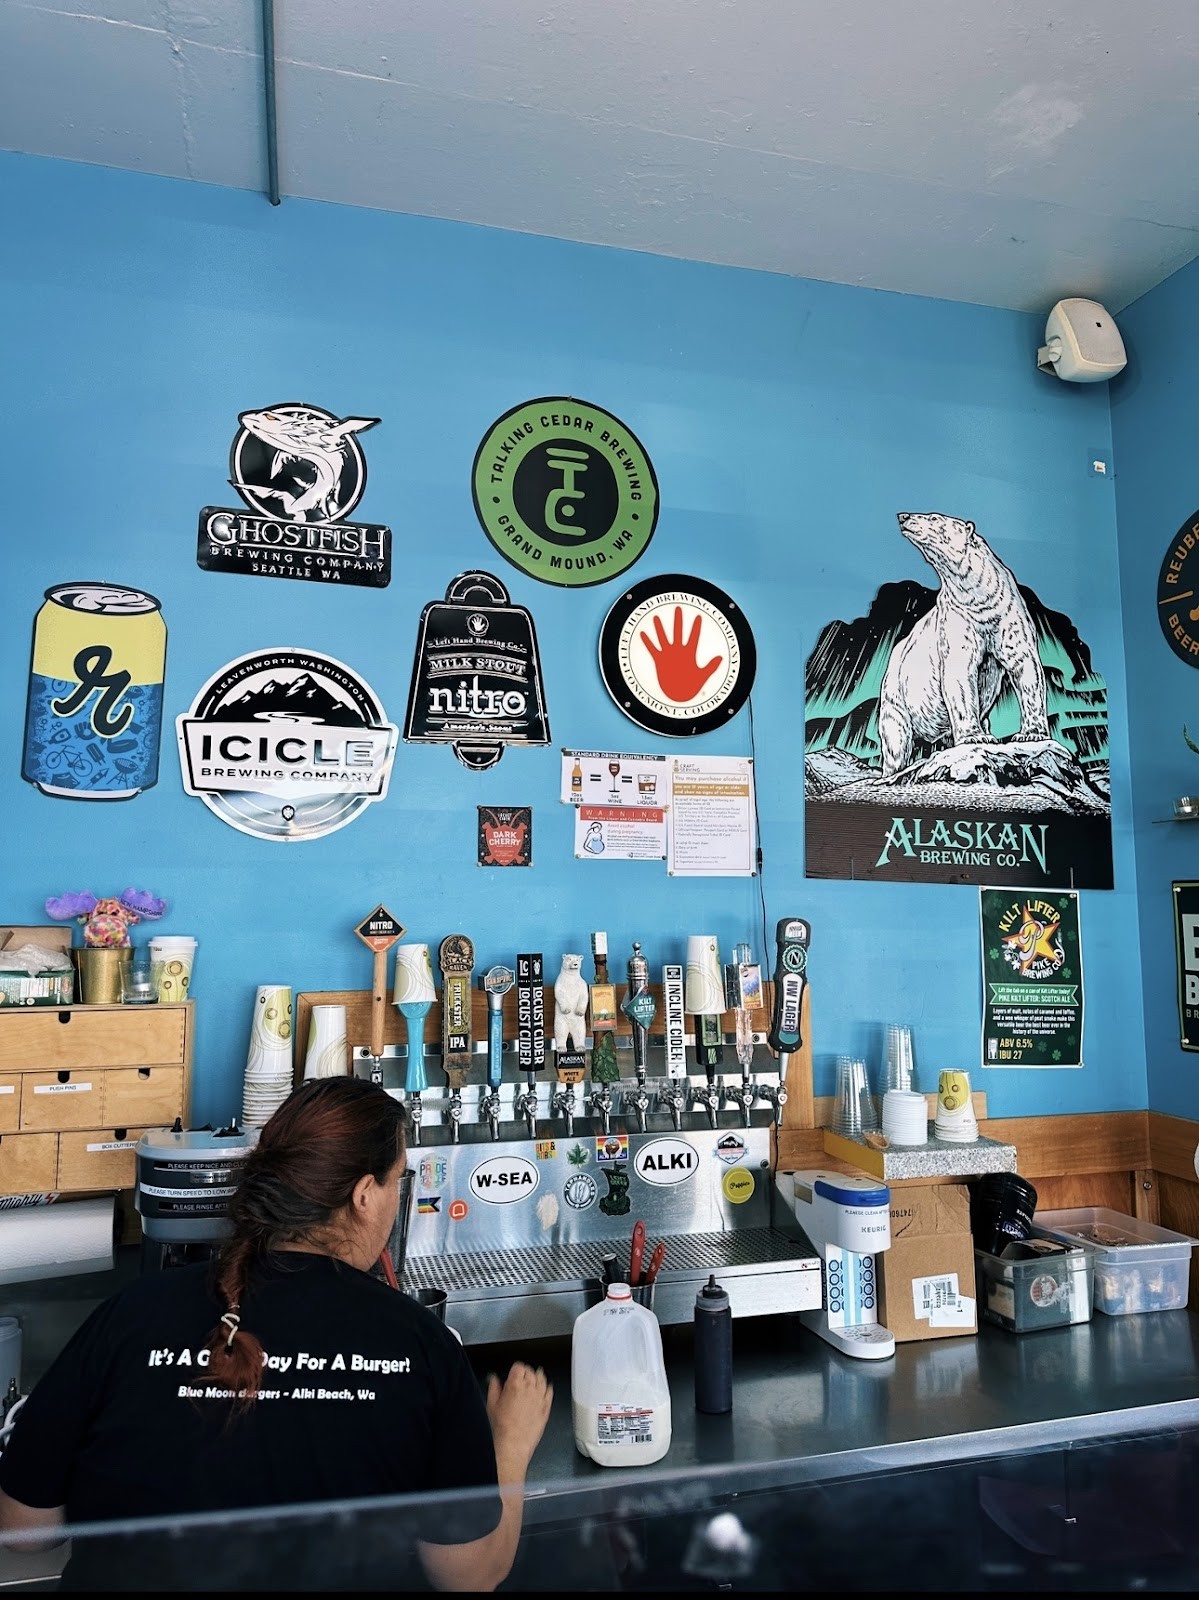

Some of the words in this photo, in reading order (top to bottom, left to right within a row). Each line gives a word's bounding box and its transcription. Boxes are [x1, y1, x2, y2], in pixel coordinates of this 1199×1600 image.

[491, 422, 533, 483] TALKING
[540, 415, 594, 433] CEDAR
[600, 430, 642, 500] BREWING
[207, 512, 389, 560] GHOSTFISH
[498, 515, 542, 560] GRAND
[550, 552, 613, 569] MOUND,
[612, 530, 633, 551] WA
[211, 546, 293, 563] BREWING
[304, 556, 384, 572] COMPANY
[252, 563, 311, 577] SEATTLE
[321, 569, 340, 580] WA
[435, 638, 451, 646] Left
[475, 637, 506, 648] Brewing
[621, 629, 631, 660] LEFT
[628, 600, 654, 626] HAND
[656, 593, 710, 611] BREWING
[712, 610, 738, 664] COMPANY
[215, 658, 295, 694] LEAVENWORTH
[300, 659, 364, 702] WASHINGTON
[430, 658, 473, 670] MILK
[475, 658, 526, 675] STOUT
[429, 675, 526, 715] nitro
[684, 674, 736, 716] COLORADO
[202, 735, 374, 767] ICICLE
[201, 768, 284, 778] BREWING
[290, 771, 373, 782] COMPANY
[489, 838, 521, 846] CHERRY
[875, 817, 1050, 875] ALASKAN
[920, 850, 991, 866] BREWING
[996, 853, 1020, 868] CO.
[370, 921, 393, 930] NITRO
[999, 903, 1021, 932] KILT
[1027, 900, 1060, 923] LIFTER
[1022, 967, 1053, 979] BREWING
[1032, 957, 1050, 969] PIKE
[453, 982, 462, 1027] TRICKSTER
[518, 987, 531, 1028] LOCUST
[532, 986, 544, 1027] LOCUST
[669, 984, 681, 1027] INCLINE
[784, 1000, 797, 1032] LAGER
[450, 1037, 465, 1048] IPA
[519, 1030, 532, 1065] CIDER
[533, 1029, 544, 1064] CIDER
[670, 1029, 683, 1061] CIDER
[1000, 1038, 1015, 1047] ABV
[1016, 1039, 1033, 1048] 6.5%
[1000, 1050, 1011, 1059] IBU
[1013, 1050, 1022, 1059] 27
[642, 1153, 691, 1171] ALKI
[476, 1171, 532, 1188] W-SEA
[861, 1225, 887, 1233] KEURIG
[148, 1348, 174, 1367] It's
[176, 1349, 192, 1366] A
[296, 1352, 327, 1370] For
[330, 1353, 346, 1371] A
[351, 1354, 411, 1374] Burger!
[178, 1385, 203, 1398] Blue
[205, 1386, 236, 1399] Moon
[292, 1387, 315, 1400] Alki
[317, 1388, 354, 1401] Beach,
[357, 1390, 376, 1400] Wa
